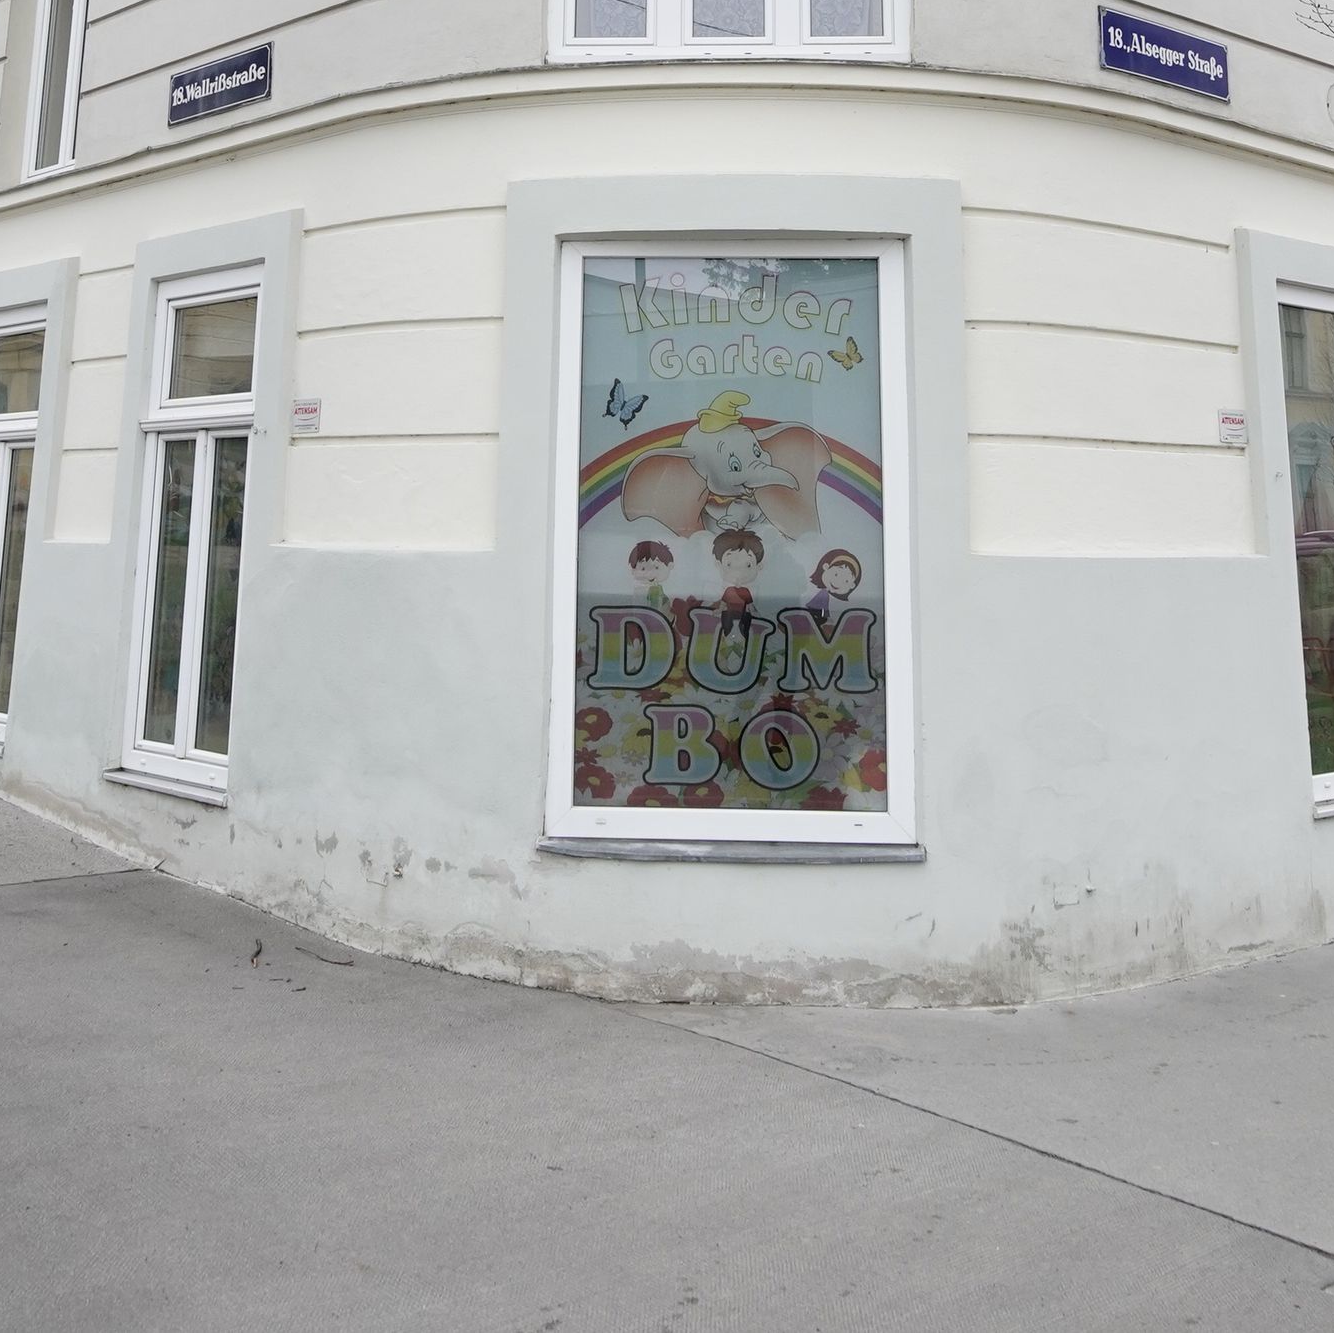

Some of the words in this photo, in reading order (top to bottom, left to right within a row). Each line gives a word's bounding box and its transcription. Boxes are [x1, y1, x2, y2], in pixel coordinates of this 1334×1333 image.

[1188, 50, 1224, 81] Straße
[619, 273, 853, 335] Kinder
[649, 334, 824, 383] Garten
[587, 605, 878, 694] DUM
[643, 704, 820, 790] BO
